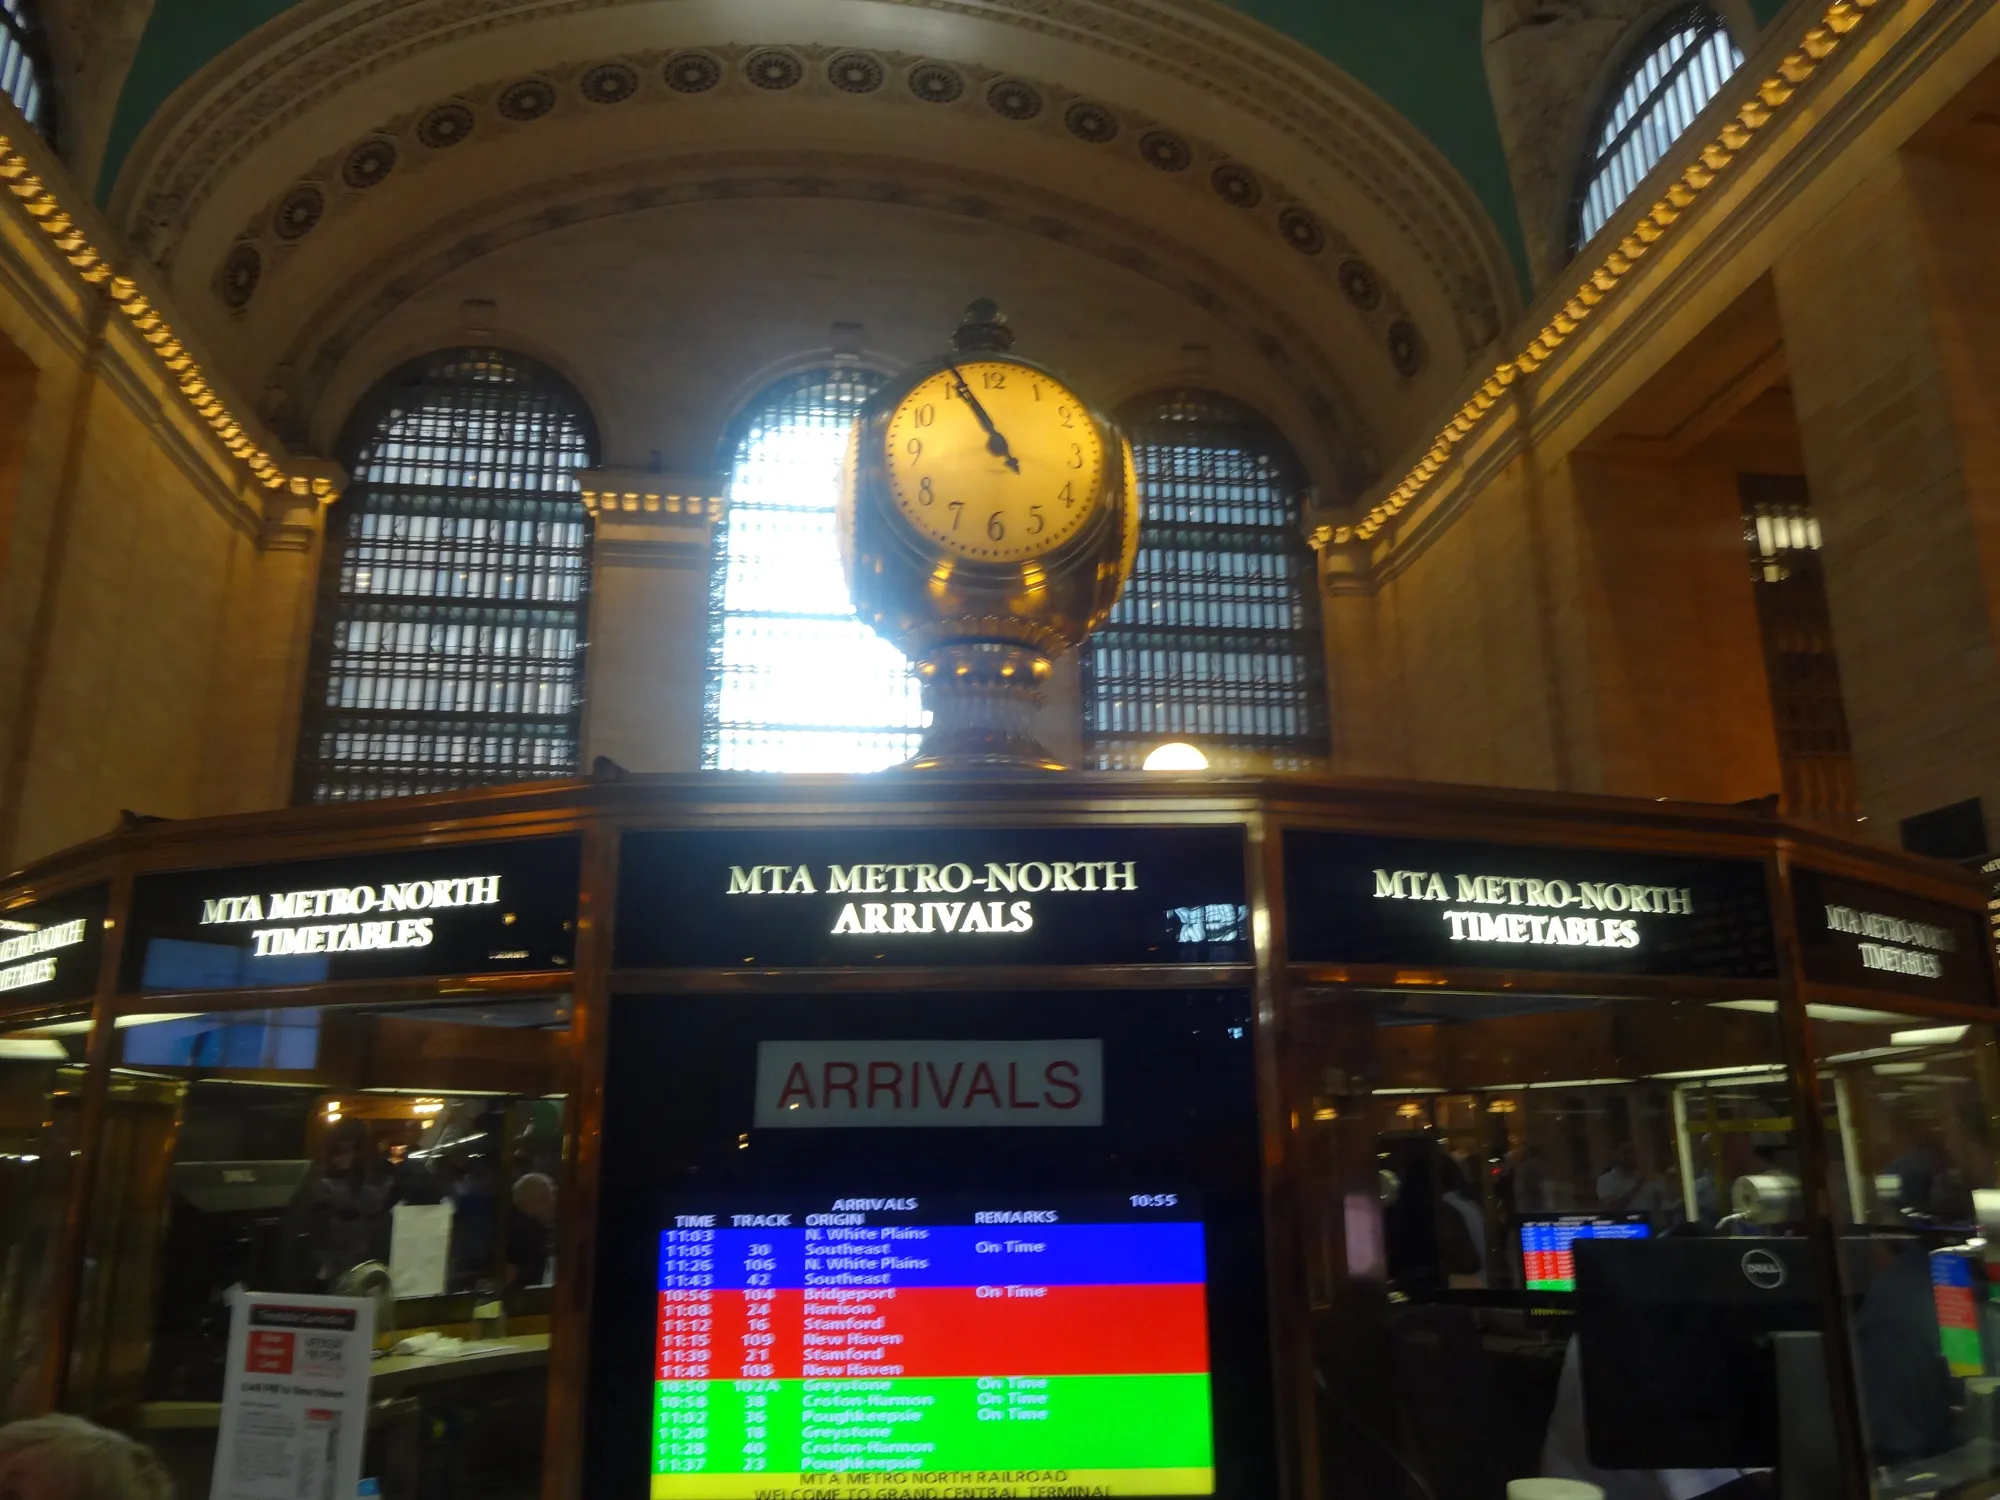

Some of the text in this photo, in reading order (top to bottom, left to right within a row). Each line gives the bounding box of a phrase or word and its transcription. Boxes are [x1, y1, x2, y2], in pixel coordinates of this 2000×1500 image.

[982, 372, 1006, 390] 12
[1031, 383, 1041, 402] 1
[913, 403, 934, 429] 10
[1058, 405, 1074, 429] 2
[906, 438, 922, 467] 9
[1067, 442, 1082, 469] 3
[918, 476, 934, 506] 8
[1057, 481, 1075, 508] 4
[948, 501, 965, 531] 7
[1026, 505, 1044, 535] 5
[987, 510, 1005, 542] 6
[726, 861, 1139, 895] MTA METRO-NORTH
[1372, 868, 1694, 915] MTA METRO-NORTH
[200, 874, 502, 924] MTA METRO-NORTH
[831, 900, 1034, 935] ARRIVALS
[1824, 904, 1862, 934] MTA
[1443, 910, 1641, 949] TIMETABLES
[252, 918, 433, 957] TIMETABLES
[1858, 942, 1943, 979] TIMETABLES
[776, 1060, 1084, 1110] ARRIVALS
[831, 1198, 919, 1211] ARRIVALS
[1129, 1194, 1178, 1207] 10:55
[674, 1214, 717, 1227] TIME
[731, 1214, 792, 1227] TRACK
[805, 1212, 865, 1226] ORIGIN
[974, 1211, 1059, 1224] REMARKS
[666, 1230, 716, 1242] 11:03
[805, 1227, 930, 1240] N. White Plains
[665, 1244, 715, 1257] 11:05
[748, 1244, 772, 1256] 30
[804, 1243, 891, 1256] Southeast
[975, 1240, 1046, 1253] On Time
[665, 1259, 714, 1272] 11:26
[744, 1259, 776, 1271] 106
[804, 1257, 930, 1271] N. White Plains
[664, 1274, 714, 1287] 11:43
[746, 1274, 771, 1286] 42
[804, 1273, 891, 1286] Southeast
[665, 1289, 713, 1302] 10:56
[742, 1289, 776, 1301] 104
[804, 1288, 897, 1303] Bridgeport
[976, 1285, 1047, 1298] On Time
[664, 1304, 712, 1317] 11:08
[746, 1304, 771, 1316] 24
[803, 1303, 875, 1316] Harrison
[663, 1319, 712, 1332] 11:12
[747, 1318, 771, 1331] 16
[803, 1317, 885, 1330] Stamford
[662, 1335, 712, 1347] 11:15
[741, 1333, 775, 1346] 109
[803, 1333, 904, 1346] New Haven
[661, 1350, 711, 1362] 11:39
[745, 1349, 770, 1362] 21
[803, 1347, 885, 1361] Stamford
[661, 1365, 710, 1378] 11:45
[740, 1364, 775, 1377] 108
[802, 1364, 904, 1377] New Haven
[802, 1380, 892, 1394] Greystone
[976, 1377, 1048, 1389] On Time
[976, 1392, 1048, 1405] On Time
[802, 1410, 923, 1425] Poughkeepsie
[976, 1408, 1048, 1421] On Time
[802, 1426, 892, 1441] Greystone
[801, 1457, 923, 1472] Poughkeepsie
[846, 1473, 906, 1485] METRO
[908, 1471, 971, 1484] NORTH
[976, 1470, 1068, 1483] RAILROAD
